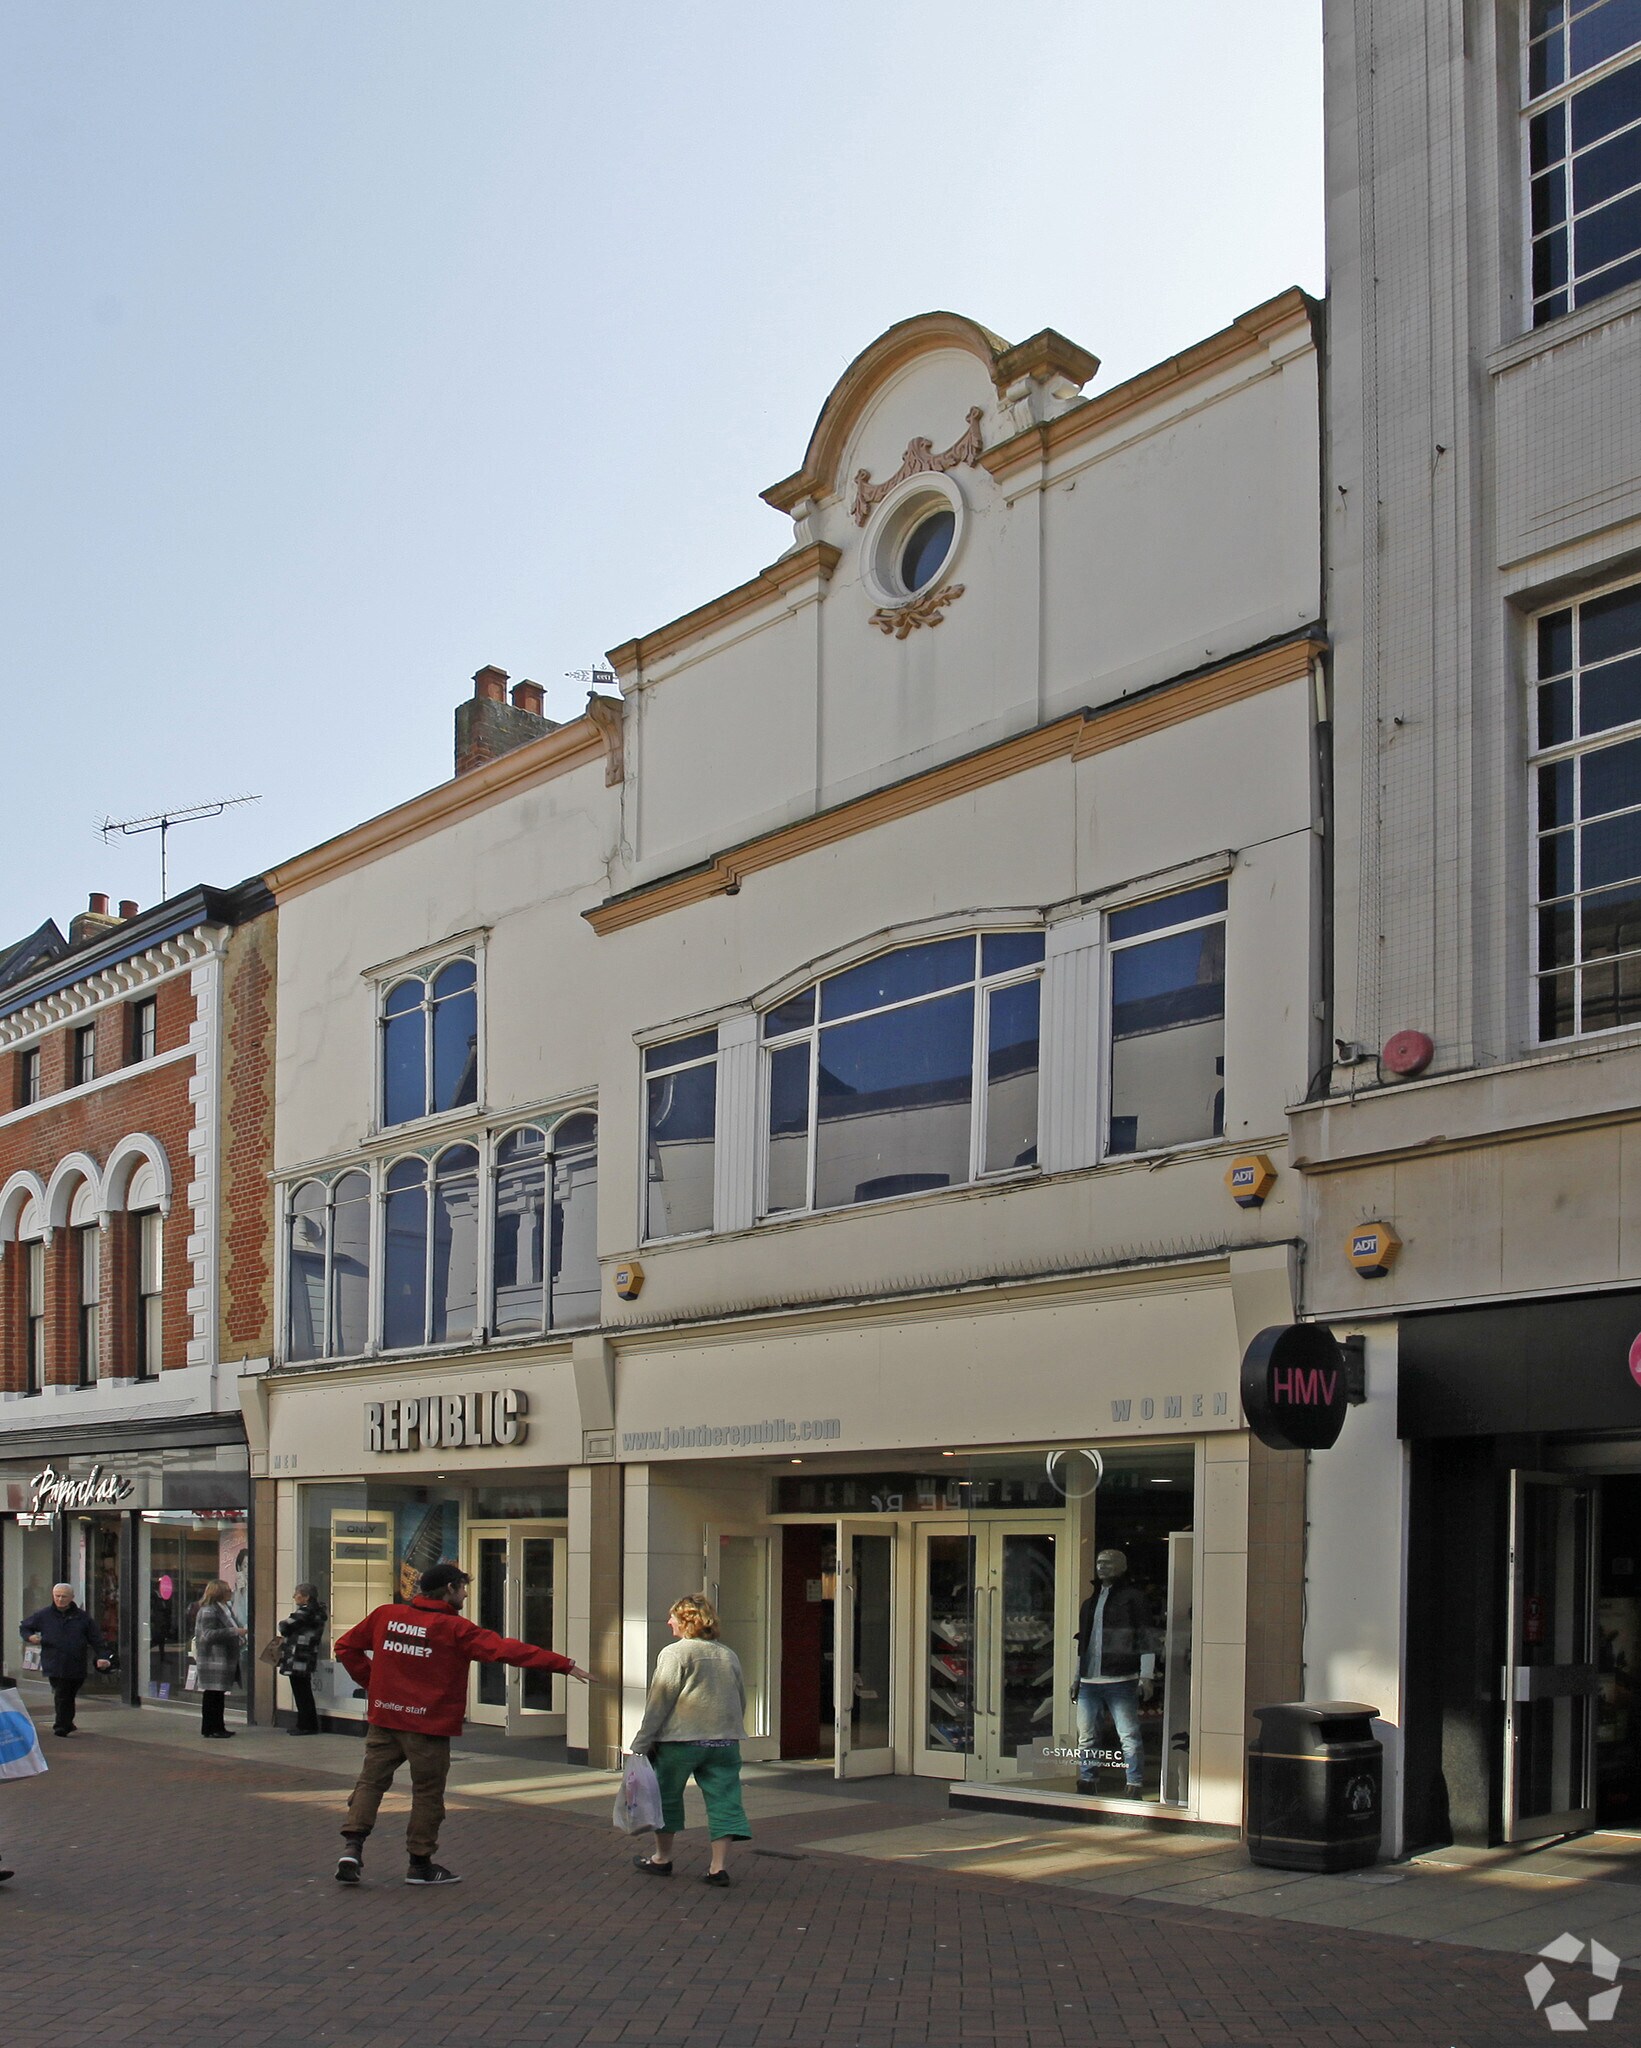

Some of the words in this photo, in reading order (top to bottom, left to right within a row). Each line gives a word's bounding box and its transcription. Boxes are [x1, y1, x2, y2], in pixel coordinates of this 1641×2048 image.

[1233, 1170, 1254, 1182] ADT
[1354, 1240, 1376, 1251] ADT
[1274, 1367, 1337, 1405] HMV
[1111, 1391, 1228, 1422] WOMEN
[363, 1388, 529, 1452] REPUBLIC
[622, 1418, 841, 1451] www.jointherepublic.com
[274, 1454, 298, 1469] MEN
[387, 1620, 427, 1638] HOME
[383, 1640, 433, 1658] HOME?
[374, 1699, 404, 1712] Shelter
[405, 1706, 427, 1715] staff
[1042, 1747, 1081, 1759] G-STAR
[1084, 1749, 1112, 1760] TYPE
[1114, 1751, 1122, 1760] C
